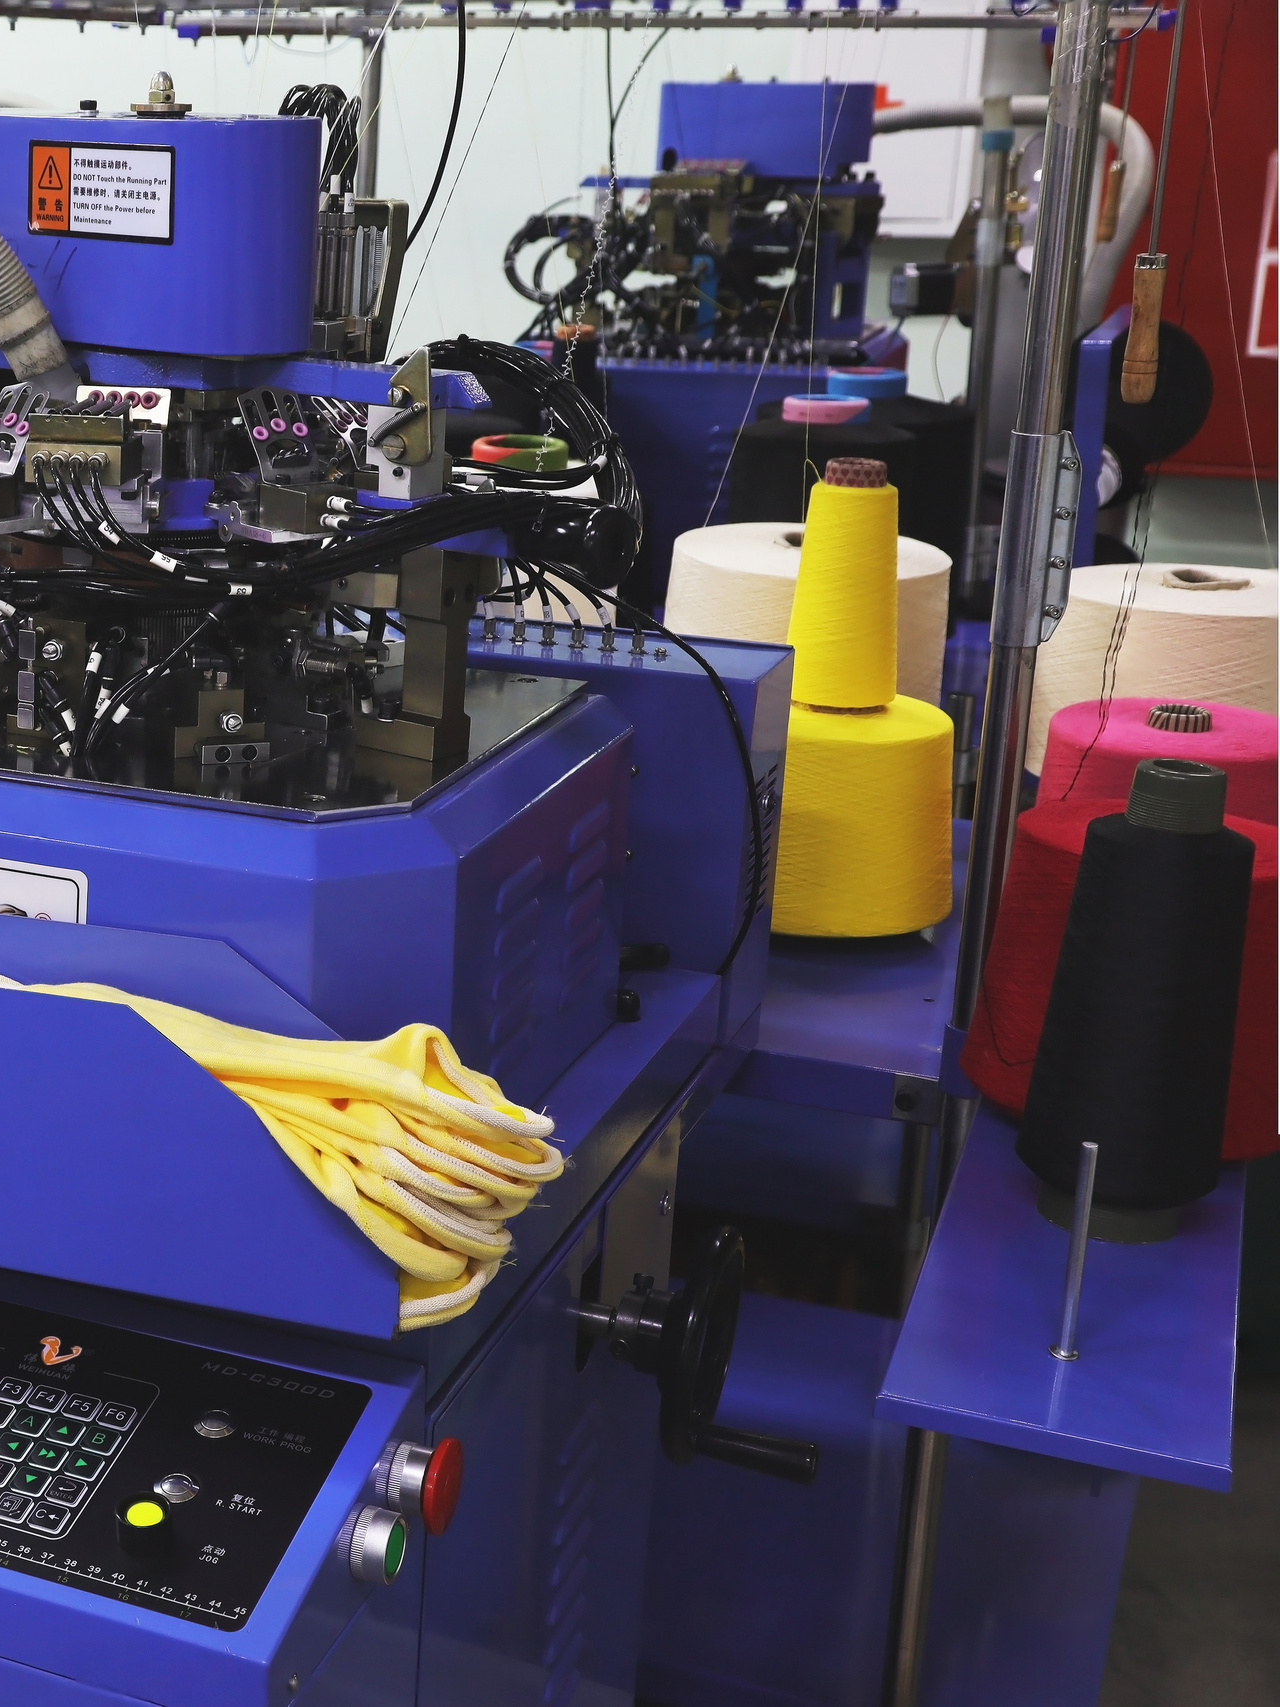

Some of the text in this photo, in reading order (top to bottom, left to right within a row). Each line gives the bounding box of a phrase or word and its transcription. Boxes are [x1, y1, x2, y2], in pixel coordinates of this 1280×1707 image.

[127, 176, 152, 186] Running
[73, 202, 89, 210] TURN
[36, 214, 64, 222] WARNING
[74, 216, 111, 224] Maintenance
[18, 1363, 70, 1380] WEIHUAN
[1, 1382, 22, 1394] F3
[36, 1391, 56, 1403] F4
[70, 1400, 91, 1412] F5
[105, 1408, 126, 1420] F6
[21, 1416, 34, 1427] A
[91, 1433, 106, 1444] B
[243, 1432, 312, 1453] WORK PROG
[50, 1490, 74, 1500] ENTER
[199, 1554, 218, 1564] JOG
[17, 1545, 31, 1553] 36
[40, 1551, 54, 1560] 37
[64, 1558, 77, 1566] 38
[87, 1565, 100, 1573] 39
[111, 1572, 124, 1580] 40
[160, 1585, 172, 1594] 42
[184, 1592, 197, 1600] 43
[209, 1599, 221, 1607] 44
[234, 1606, 247, 1614] 45
